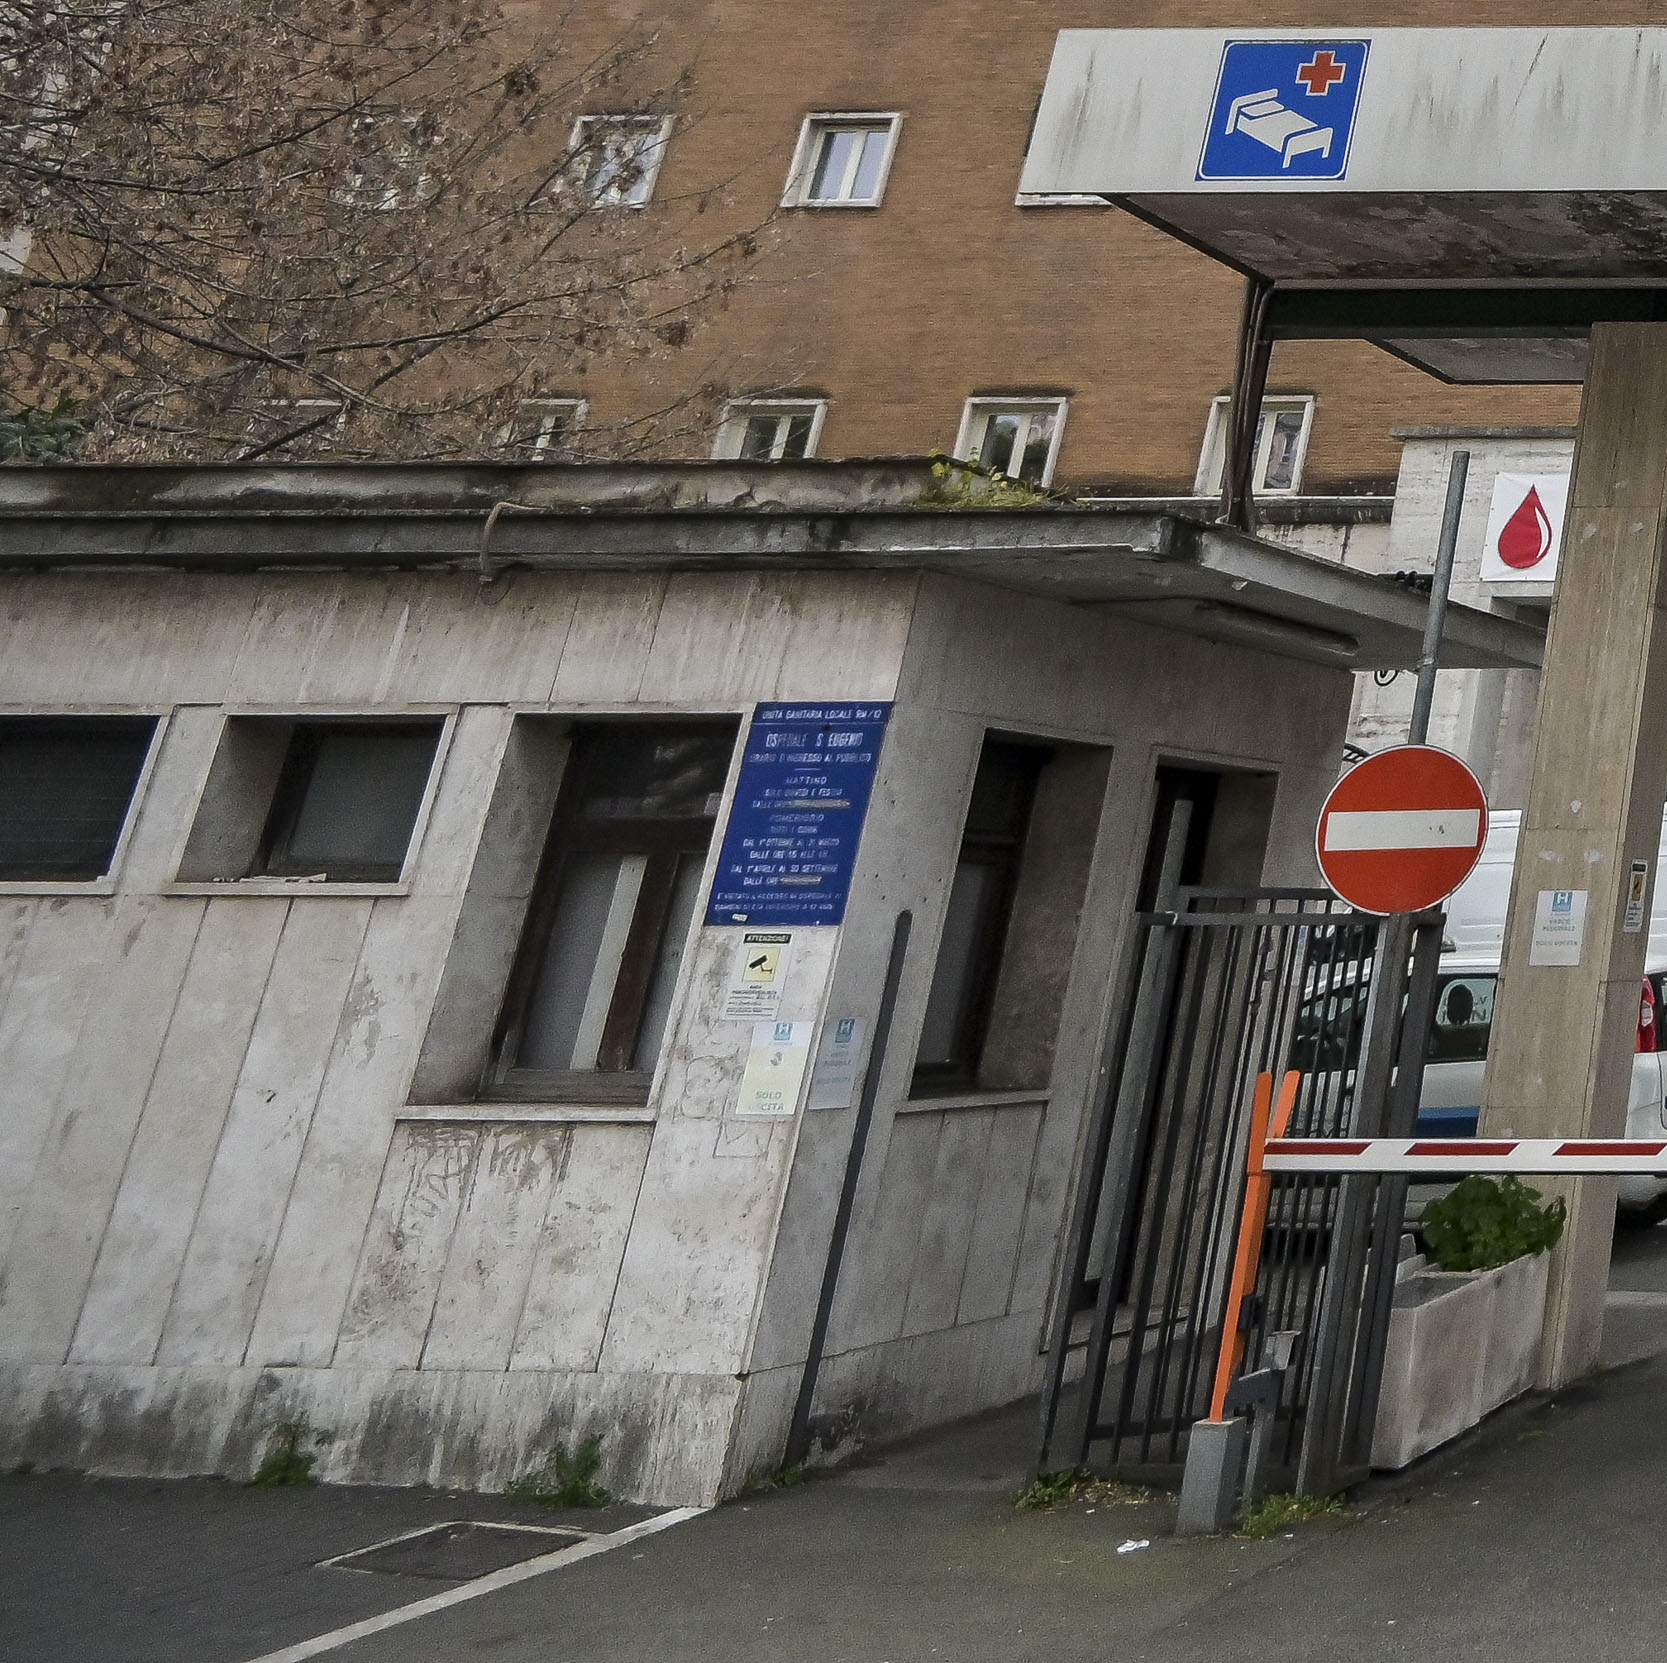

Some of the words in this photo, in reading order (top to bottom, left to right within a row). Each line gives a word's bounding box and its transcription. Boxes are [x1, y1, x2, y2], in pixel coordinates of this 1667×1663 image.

[785, 709, 823, 720] SANITARIA
[824, 709, 853, 720] LOCALE
[765, 732, 809, 748] OSPEDALE
[827, 732, 864, 748] EUGENIO
[785, 775, 828, 786] MATTINO
[755, 1090, 783, 1100] SOLO
